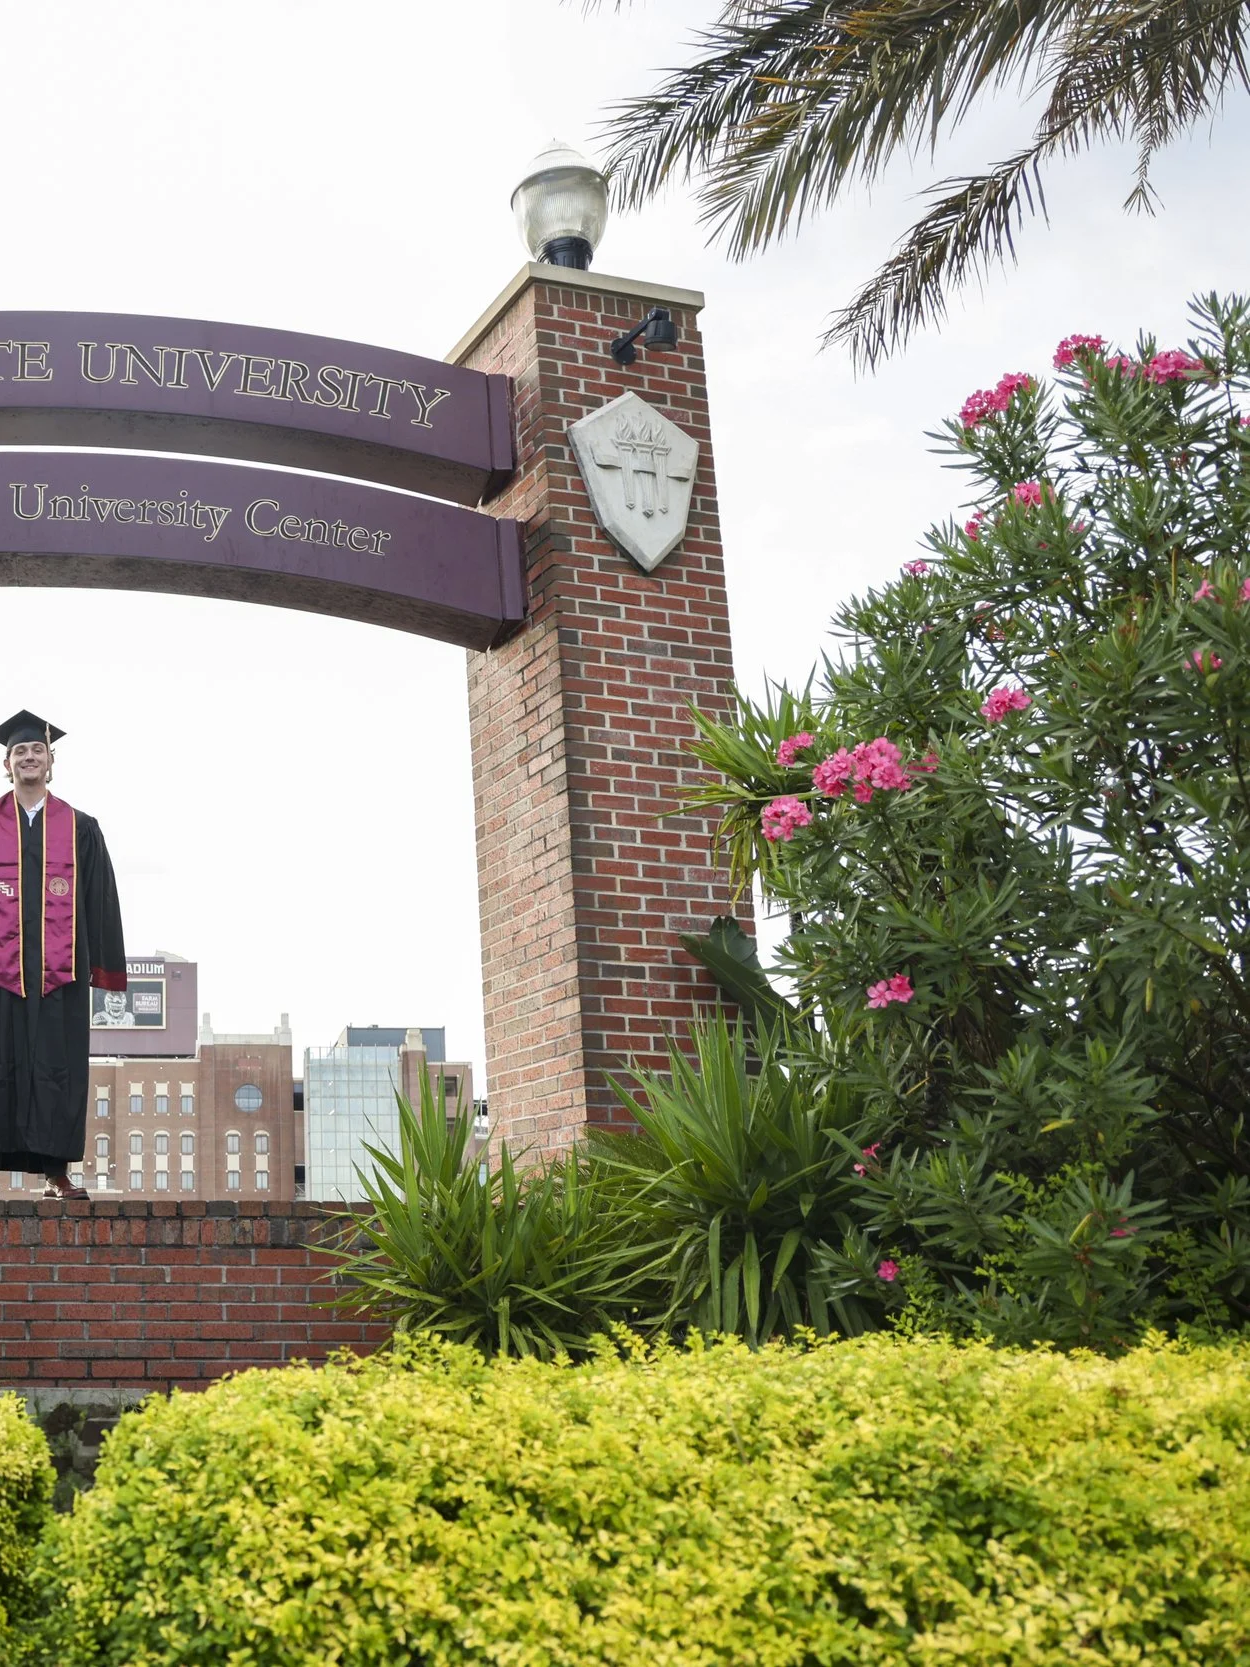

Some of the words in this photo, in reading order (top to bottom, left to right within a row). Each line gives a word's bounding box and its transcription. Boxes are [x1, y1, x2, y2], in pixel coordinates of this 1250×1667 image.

[77, 342, 450, 428] UNIVERSITY
[9, 484, 231, 542] University
[244, 499, 391, 556] Center
[126, 963, 165, 974] ADIUM
